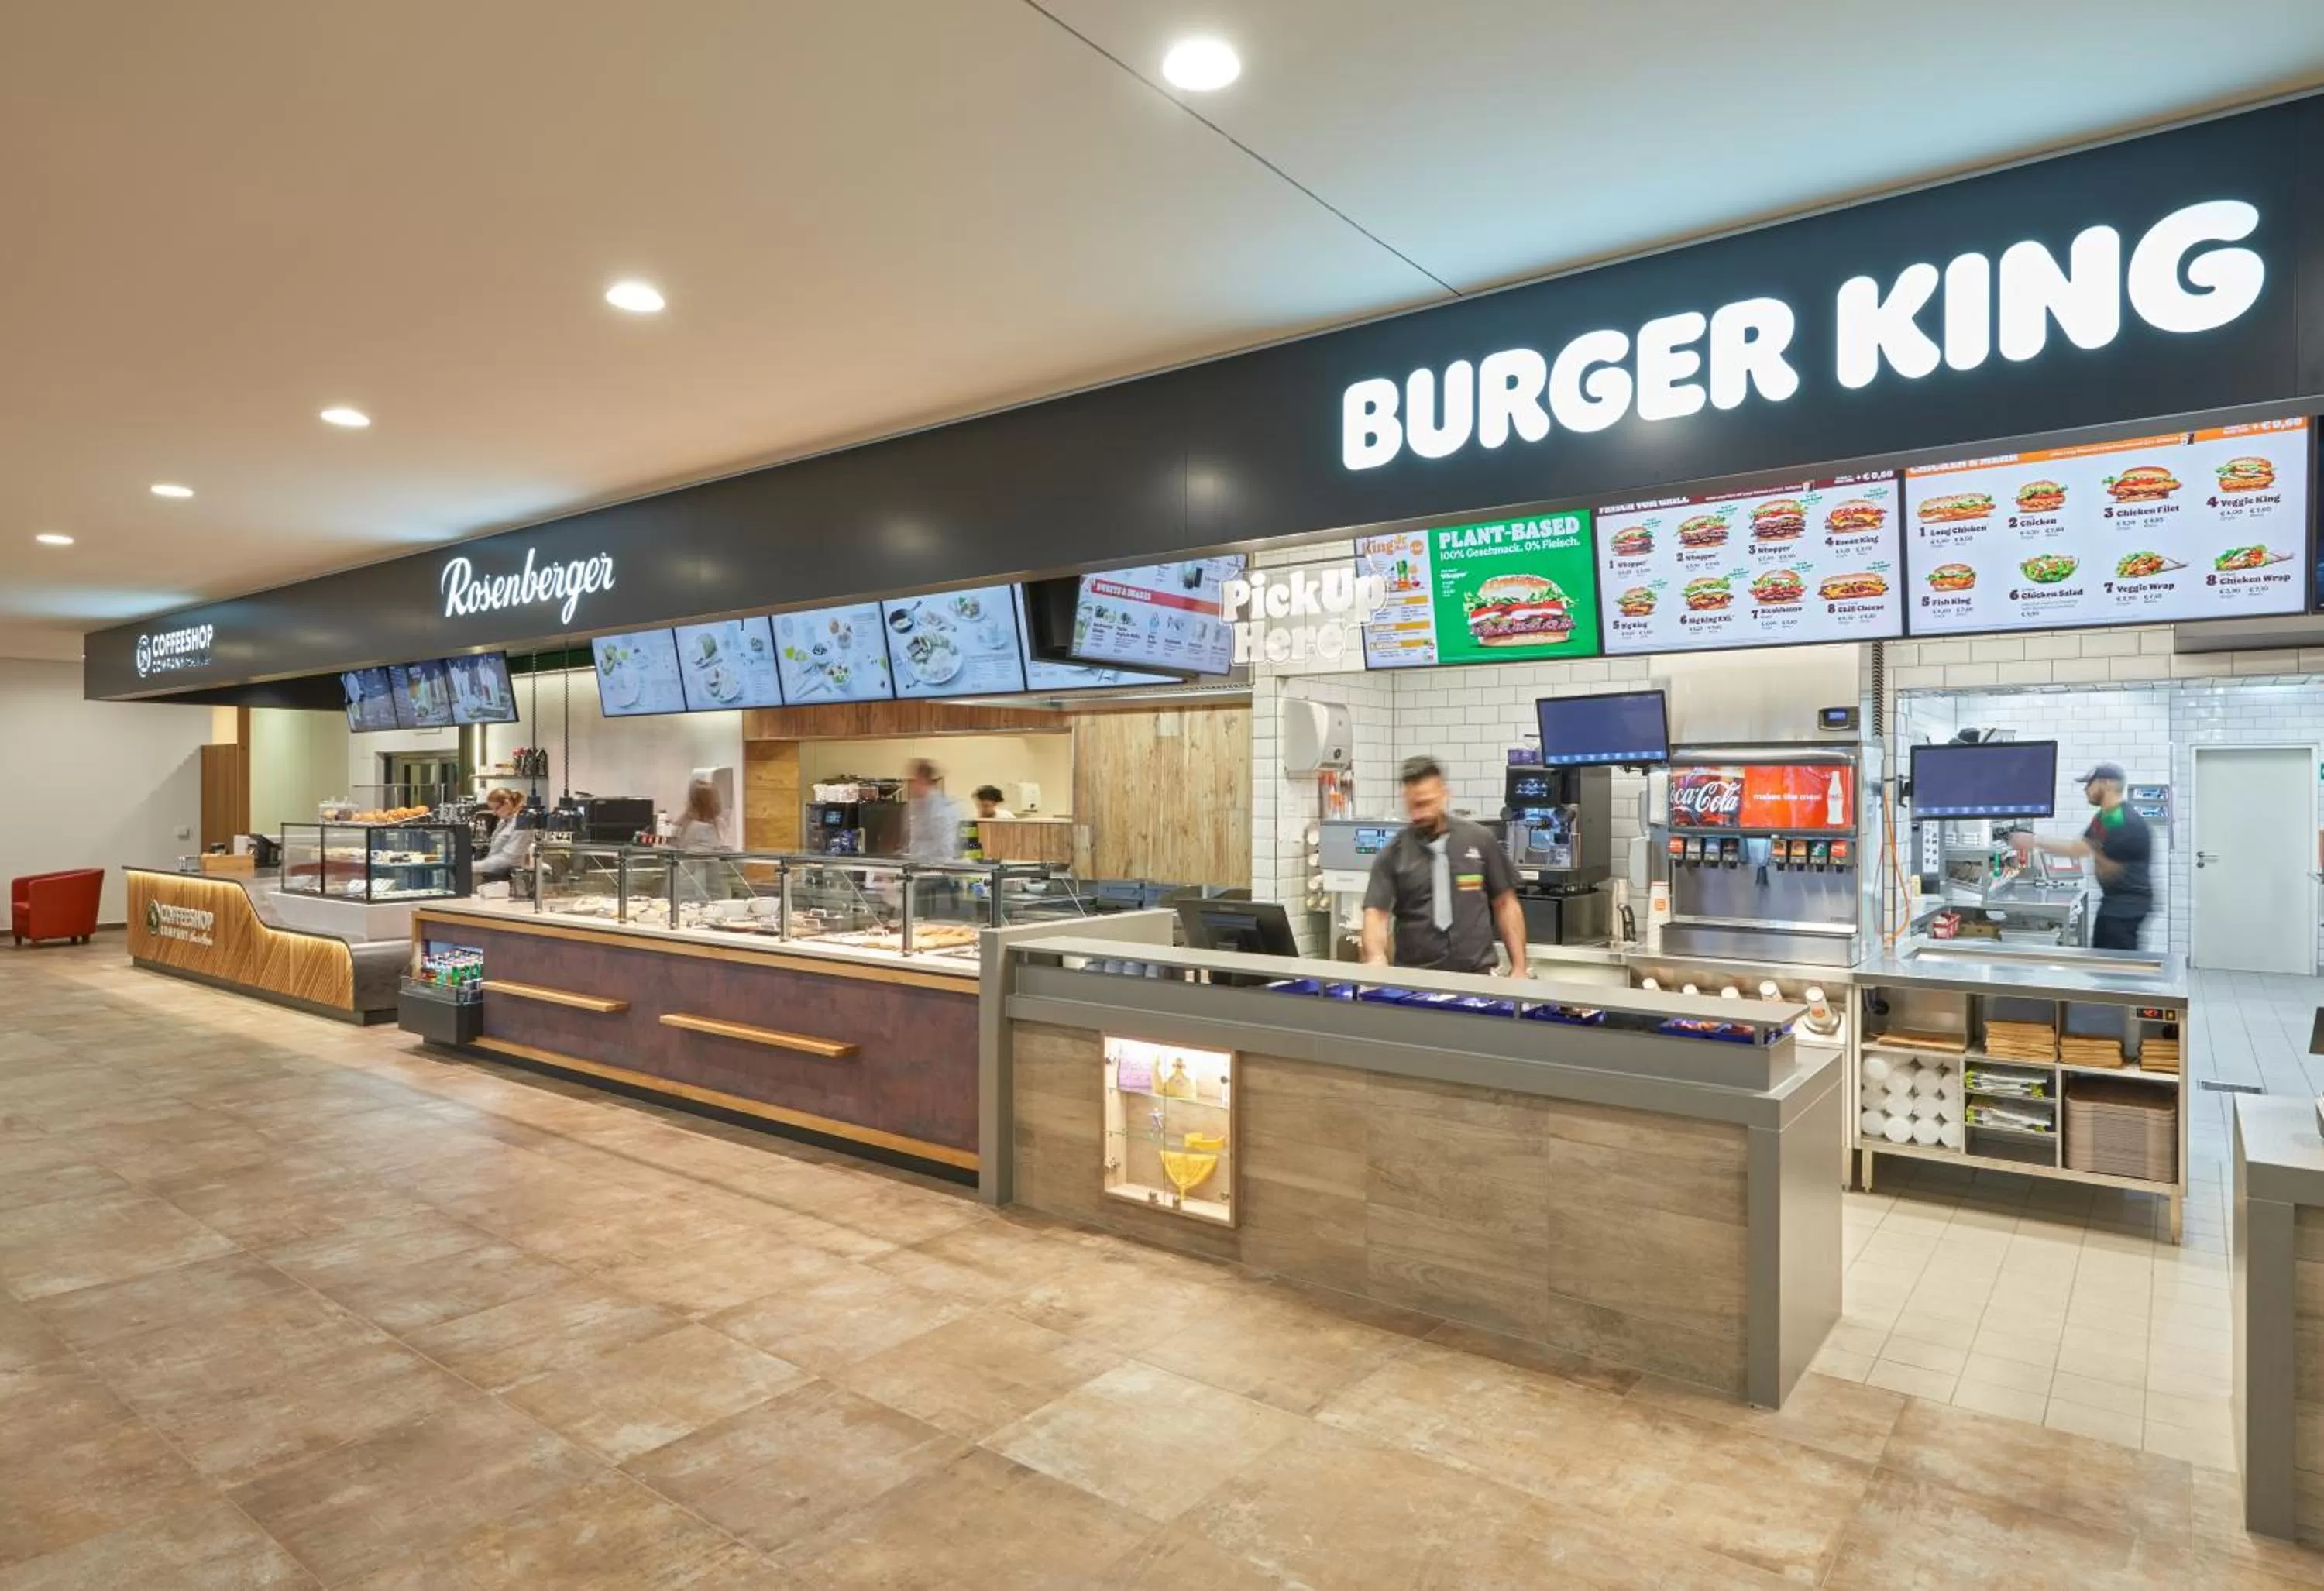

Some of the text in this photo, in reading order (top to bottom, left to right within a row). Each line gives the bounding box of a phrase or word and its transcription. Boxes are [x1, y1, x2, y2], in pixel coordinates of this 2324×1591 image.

[1342, 199, 2265, 471] BURGER KING
[2206, 493, 2281, 510] 4 Veggie King
[2104, 505, 2180, 518] 3 Chicken Filet
[2009, 517, 2058, 528] 2 Chicken
[1439, 517, 1580, 549] PLANT-BASED
[1920, 524, 1987, 537] 1 Long Chicken
[1825, 537, 1834, 547] 4
[1440, 536, 1580, 561] 100% Geschmack. 0% Fleisch.
[1748, 545, 1755, 555] 3
[1676, 552, 1683, 562] 2
[1610, 560, 1614, 569] 1
[2206, 572, 2291, 586] 8 Chicken Wrap
[442, 548, 615, 624] Rosenberger
[2104, 582, 2174, 594] 7 Veggie Wrap
[2009, 588, 2083, 600] 6 Chicken Salad
[1922, 596, 1972, 607] 5 Fish King
[1751, 610, 1758, 619] 7
[1827, 603, 1836, 614] 8
[1613, 620, 1620, 629] 5
[1680, 615, 1687, 624] 6
[153, 624, 213, 657] COFFEESHOP
[1234, 621, 1343, 664] Here
[161, 904, 213, 931] COFFEESHOP
